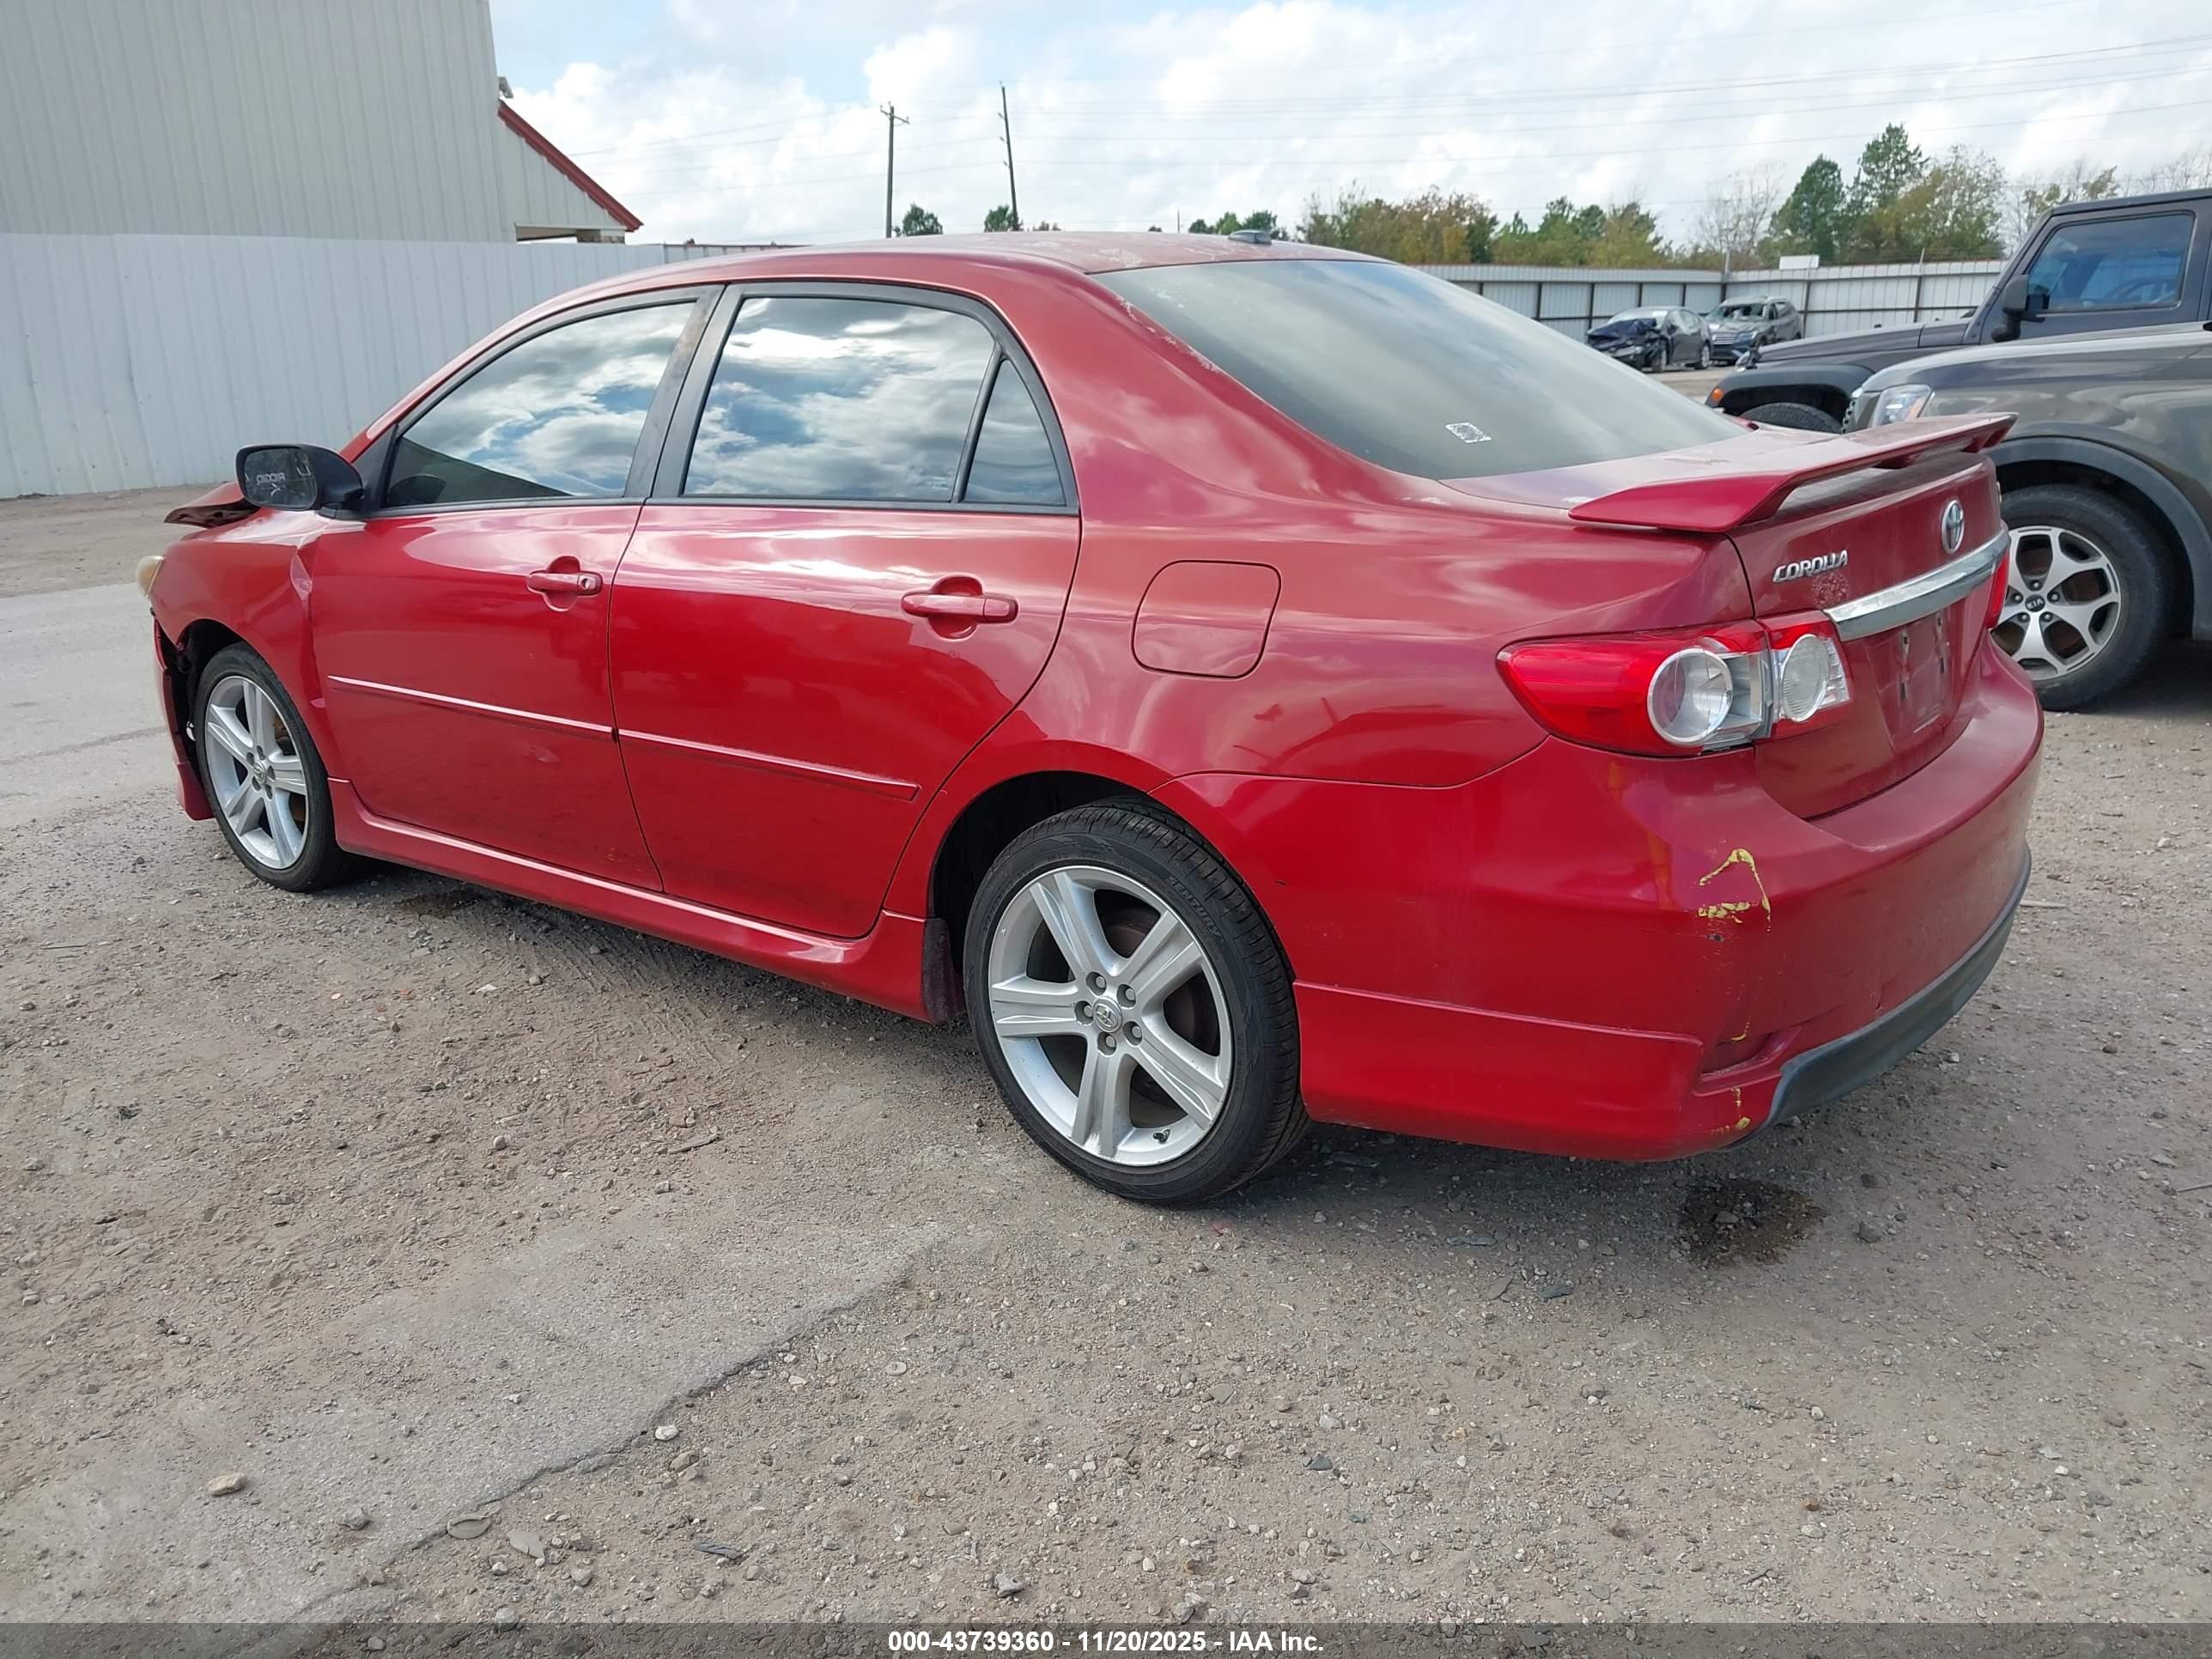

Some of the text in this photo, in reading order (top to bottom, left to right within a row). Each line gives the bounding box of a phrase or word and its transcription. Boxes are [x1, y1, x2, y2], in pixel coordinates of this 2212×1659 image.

[1772, 550, 1848, 583] COROLLA
[2026, 598, 2044, 610] KIA
[1165, 875, 1222, 936] SENTURY
